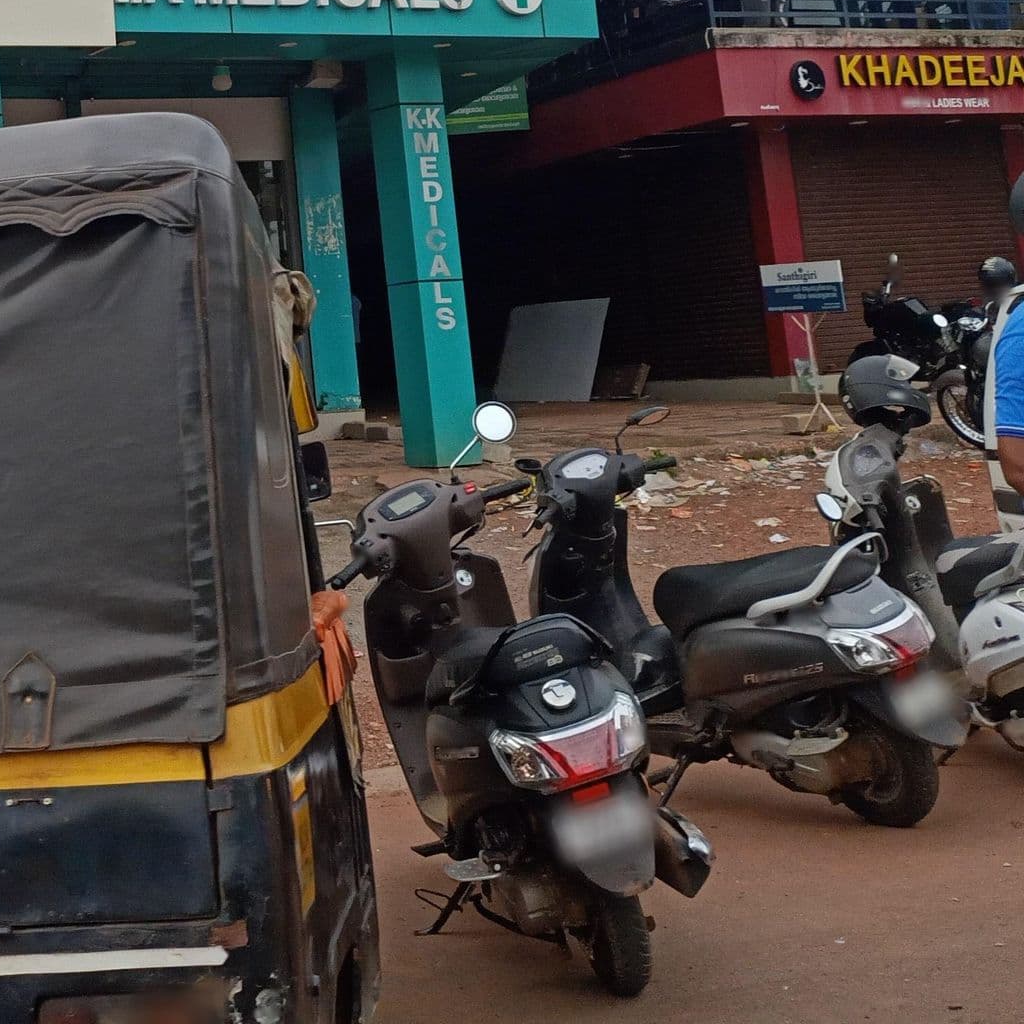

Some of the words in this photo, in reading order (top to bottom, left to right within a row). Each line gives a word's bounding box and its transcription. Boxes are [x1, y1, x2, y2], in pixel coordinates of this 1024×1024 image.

[837, 54, 1024, 87] KHADEEJA
[932, 97, 963, 108] LADIES
[964, 97, 990, 108] WEAR
[413, 132, 456, 329] MEDICALS
